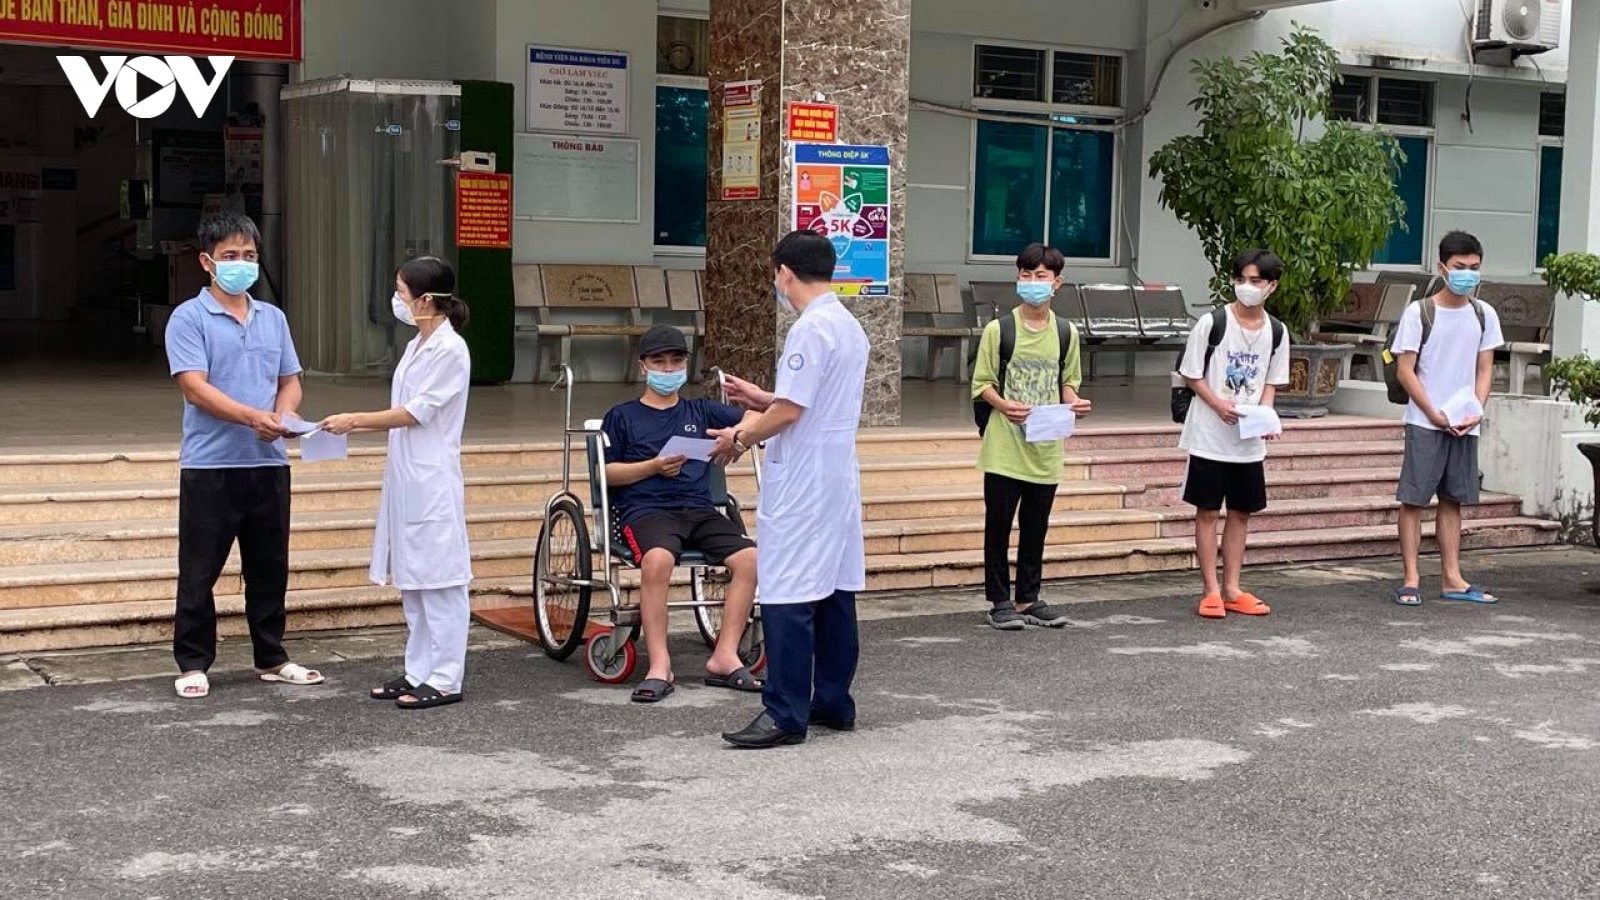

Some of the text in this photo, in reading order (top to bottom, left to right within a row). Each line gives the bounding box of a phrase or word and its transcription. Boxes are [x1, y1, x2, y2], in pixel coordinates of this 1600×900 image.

[177, 1, 196, 35] VÀ
[201, 3, 240, 42] CỘNG
[552, 140, 604, 152] THÔNG BÁO
[818, 149, 842, 158] THÔNG
[842, 150, 860, 160] ĐIỆP
[831, 219, 850, 232] 5K
